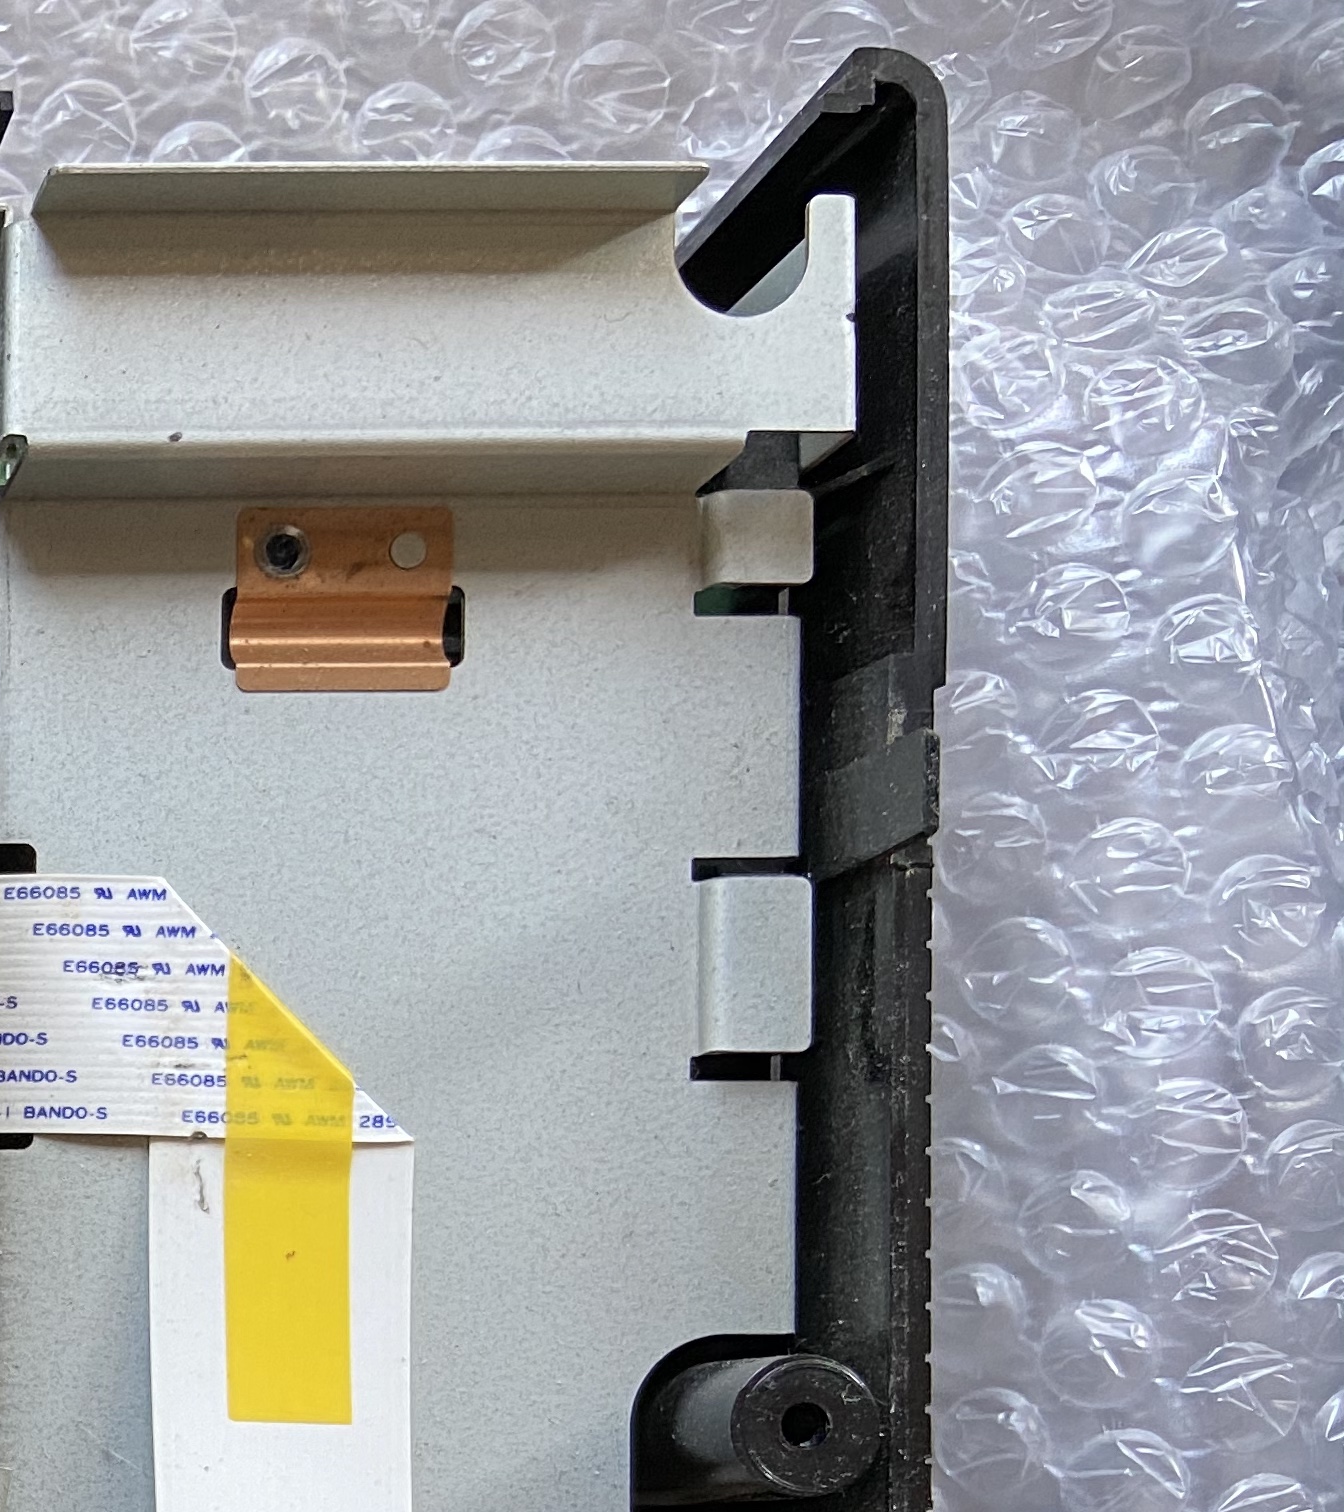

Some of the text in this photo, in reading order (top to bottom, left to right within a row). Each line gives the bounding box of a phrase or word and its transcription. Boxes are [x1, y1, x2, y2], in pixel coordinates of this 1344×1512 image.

[3, 885, 168, 901] E66085 AWM
[32, 922, 197, 939] E66085 AWM
[62, 959, 227, 977] E66085 AWM
[91, 997, 170, 1013] E66085
[122, 1034, 200, 1049] E66085
[151, 1073, 227, 1088] E66085
[23, 1106, 108, 1121] BANDO-S
